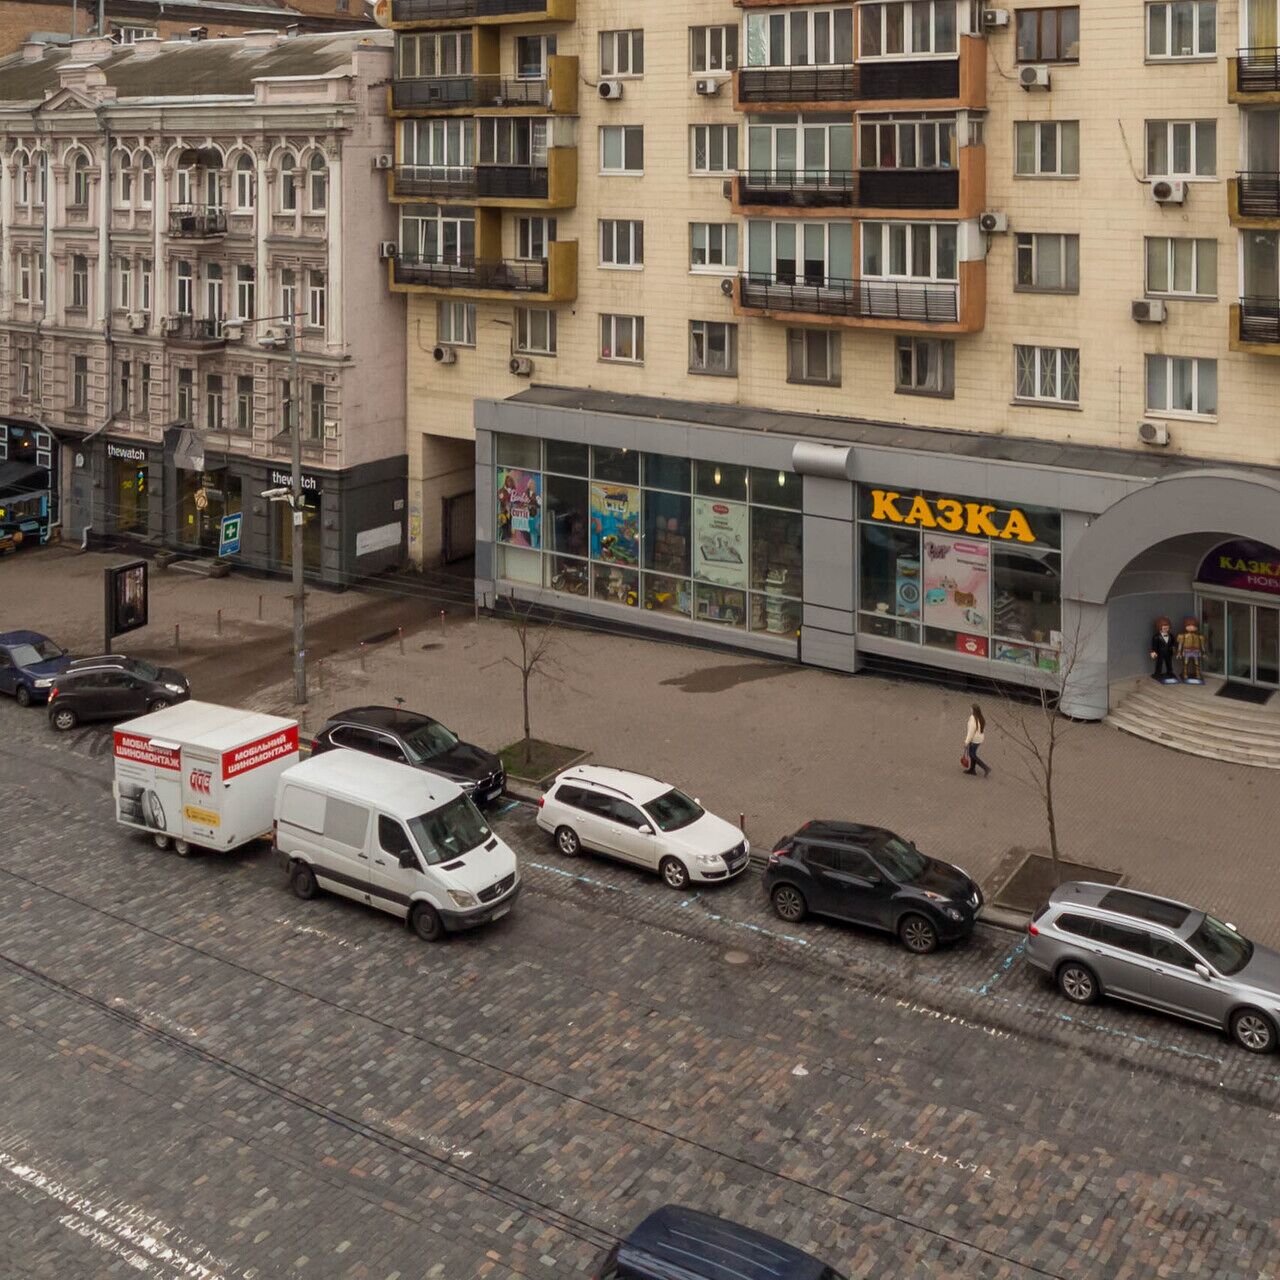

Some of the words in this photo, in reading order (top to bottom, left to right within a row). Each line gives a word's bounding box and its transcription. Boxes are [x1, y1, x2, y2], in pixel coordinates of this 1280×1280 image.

[107, 444, 145, 461] thewatch
[272, 471, 316, 489] thewtch
[871, 490, 1036, 543] КАЗКА
[116, 745, 180, 768] ШИНОМОНТАЖ
[228, 742, 293, 774] ШИНОМОНТАЖ
[235, 734, 287, 762] МОБІЛЬНИЙ
